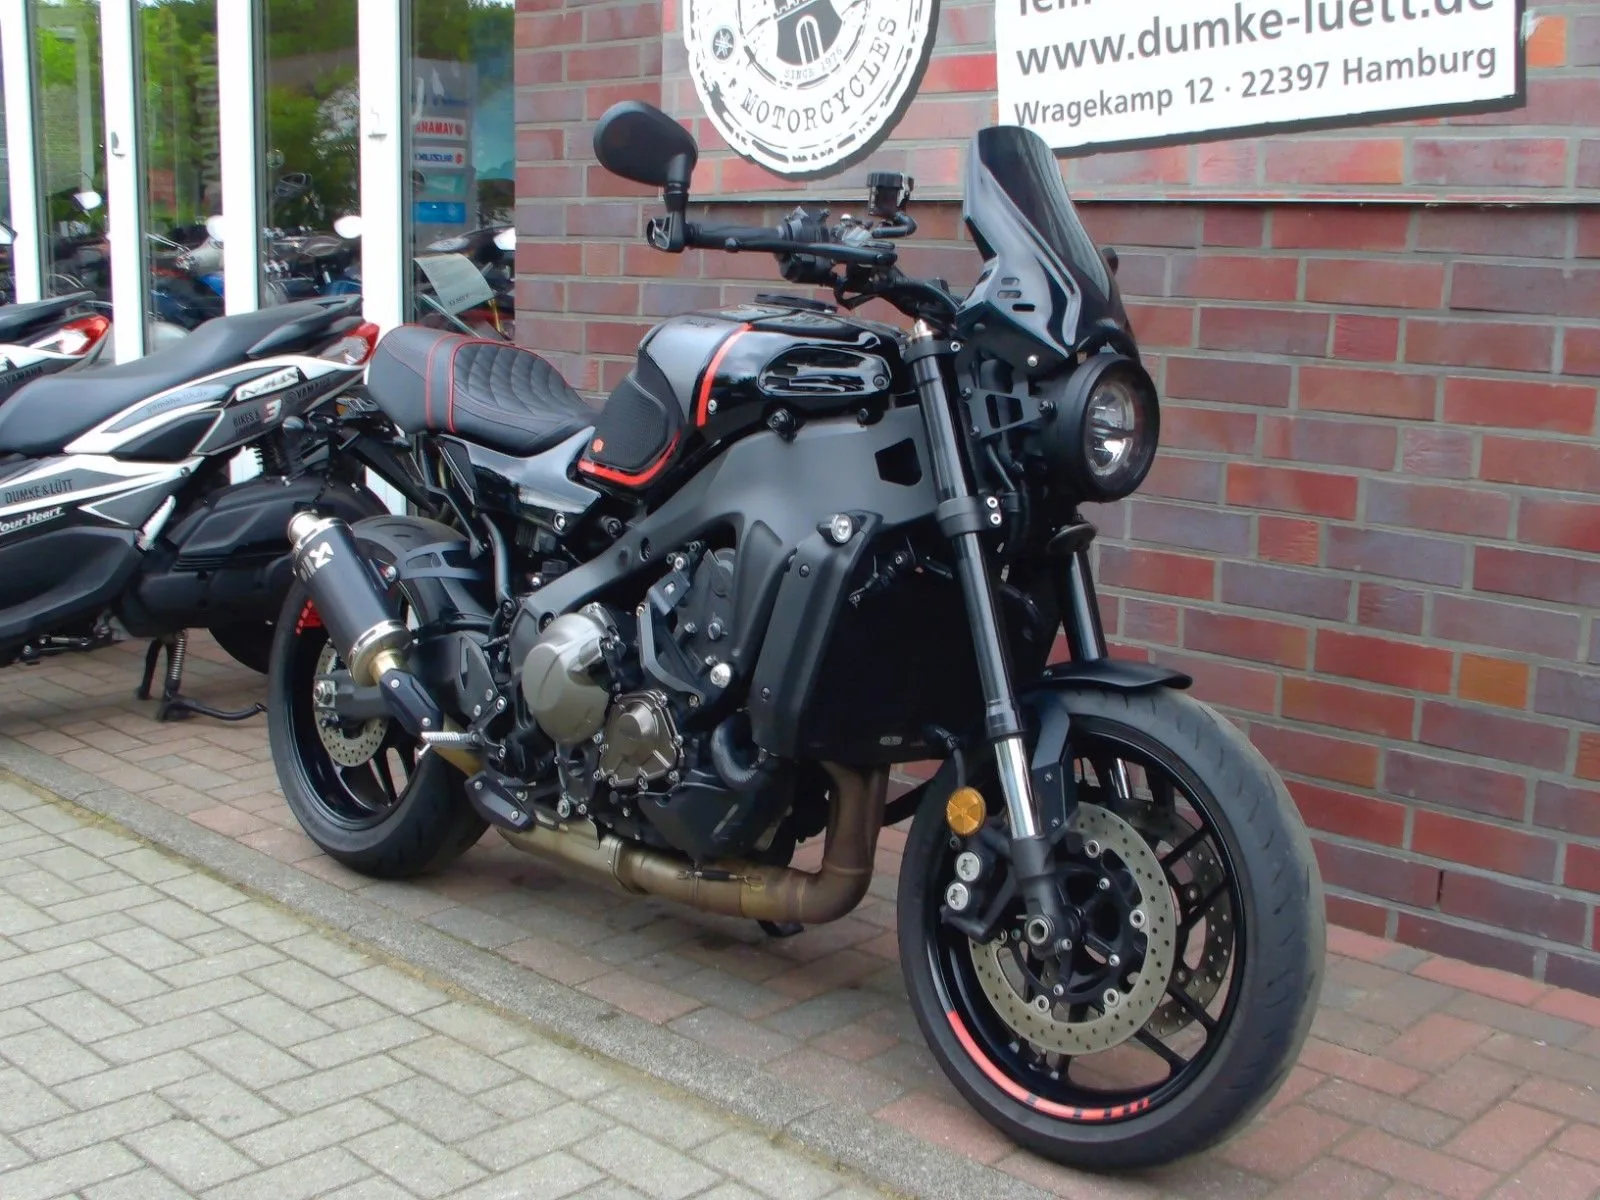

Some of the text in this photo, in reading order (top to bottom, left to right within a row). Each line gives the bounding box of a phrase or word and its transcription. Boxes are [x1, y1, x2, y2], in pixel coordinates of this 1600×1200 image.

[740, 16, 898, 133] MOTORCYCLES
[784, 68, 815, 81] SINCE
[1014, 88, 1173, 127] Wragekamp
[1185, 76, 1215, 105] 12
[1241, 61, 1330, 98] 22397
[1343, 47, 1496, 86] Hamburg
